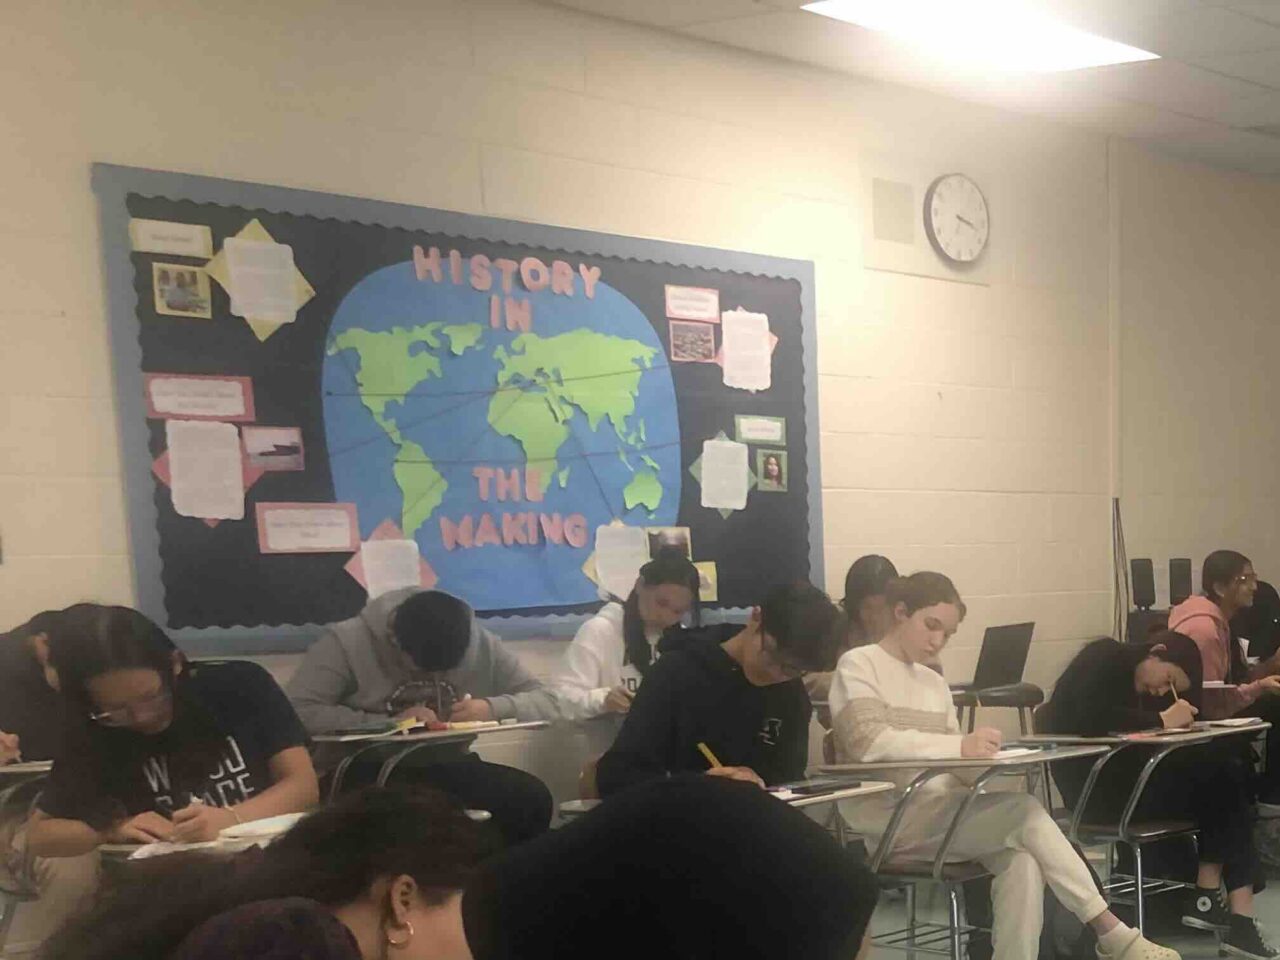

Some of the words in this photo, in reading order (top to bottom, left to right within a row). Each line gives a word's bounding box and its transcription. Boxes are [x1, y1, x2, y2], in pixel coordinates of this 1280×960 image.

[413, 244, 601, 299] HISTORY
[490, 294, 531, 334] IN
[472, 466, 544, 502] THE
[439, 511, 588, 551] MAKING
